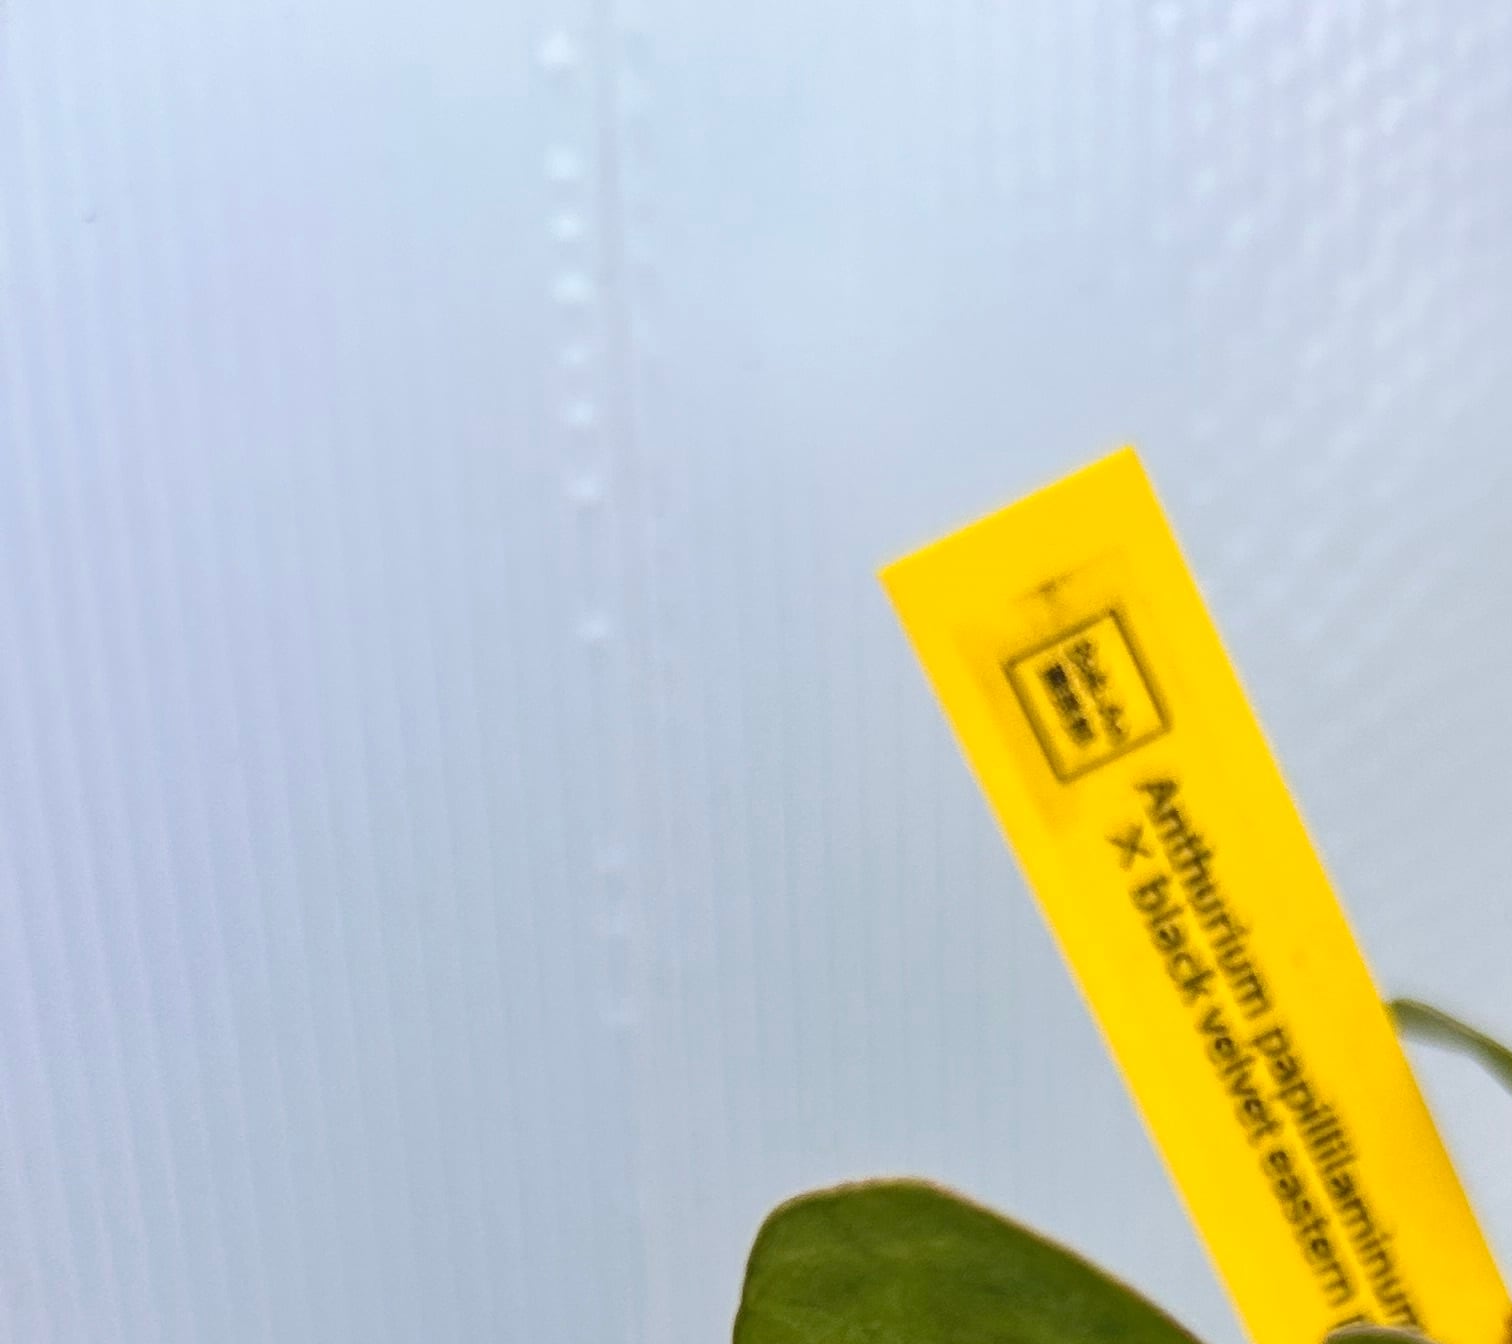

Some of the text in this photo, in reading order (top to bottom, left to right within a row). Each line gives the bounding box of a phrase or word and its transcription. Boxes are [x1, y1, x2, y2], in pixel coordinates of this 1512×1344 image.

[1134, 779, 1271, 1019] Anthurium
[1128, 873, 1215, 1007] black
[1196, 1006, 1284, 1147] velvet
[1260, 1149, 1356, 1308] eastern
